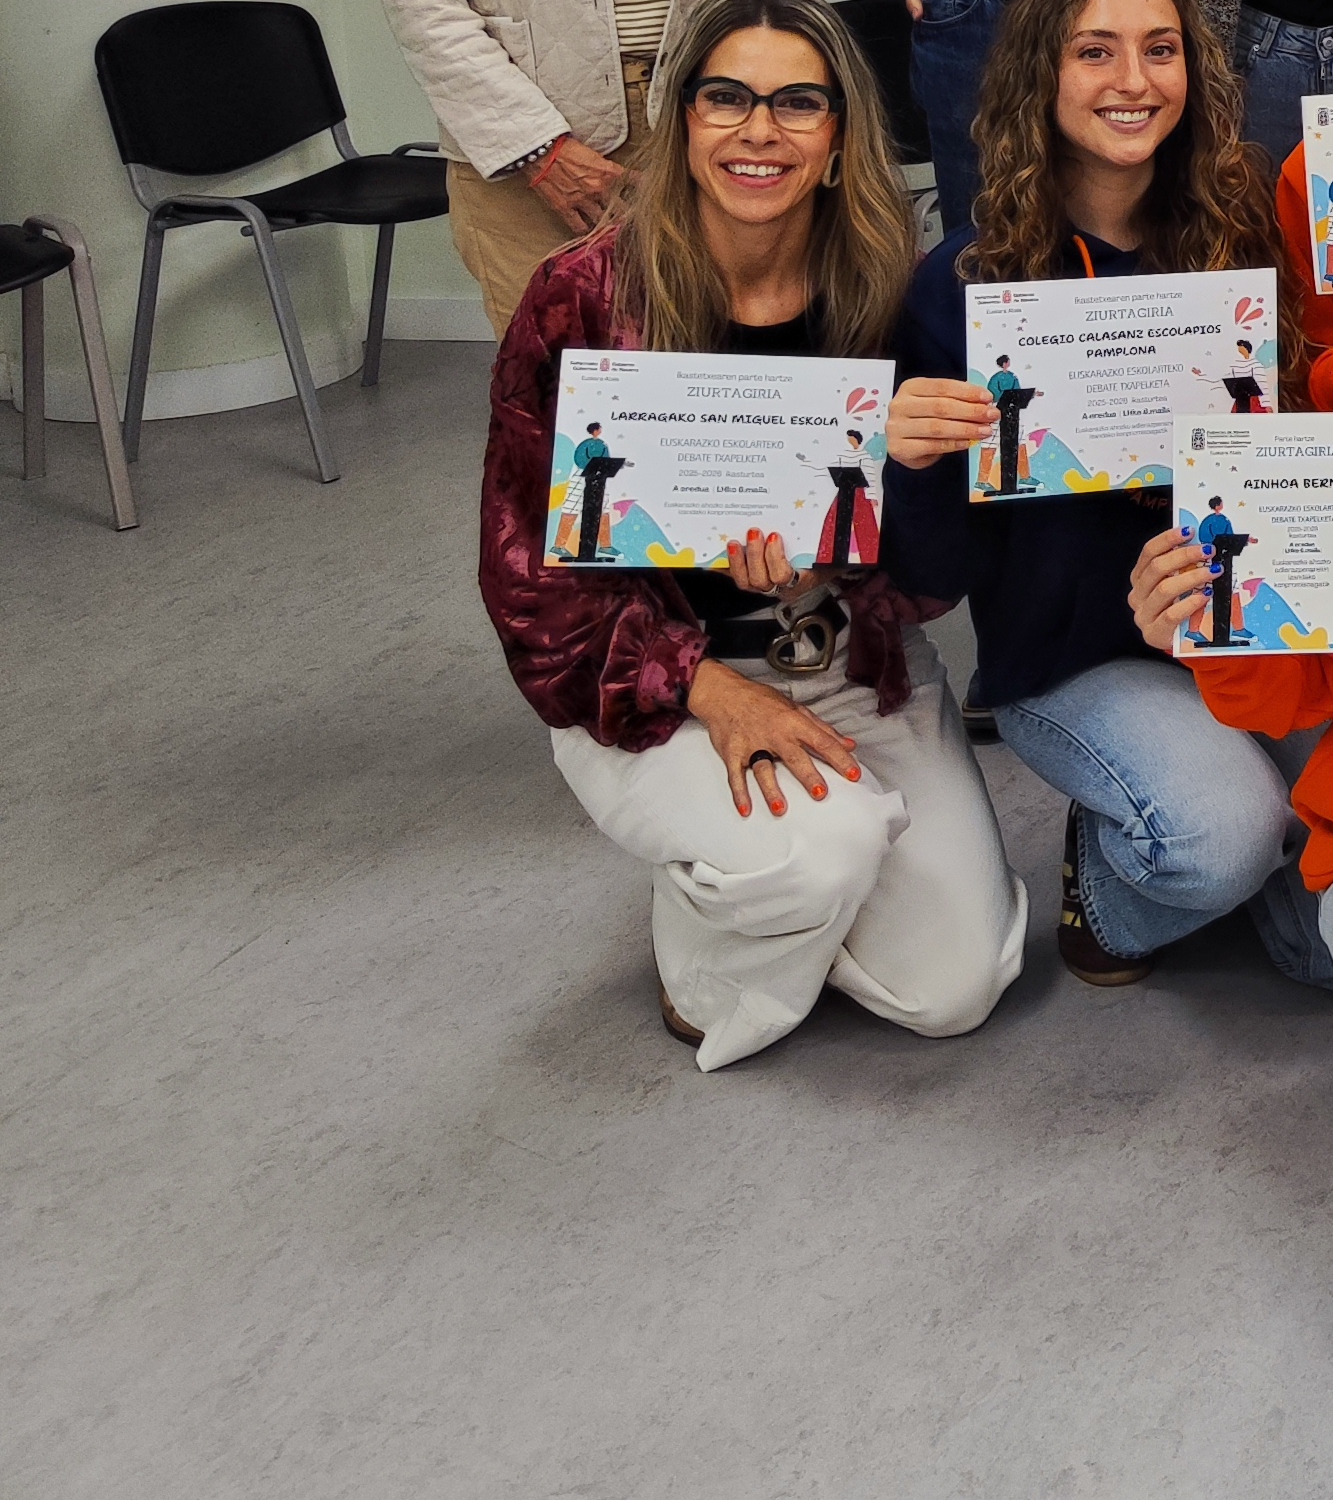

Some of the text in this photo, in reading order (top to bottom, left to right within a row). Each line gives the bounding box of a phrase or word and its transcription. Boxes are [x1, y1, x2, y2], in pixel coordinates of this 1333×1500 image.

[1085, 306, 1174, 322] ZIURTAGIRIA
[1018, 324, 1221, 347] COLEGIO CALASANZ ESCOLAPIOS
[1086, 345, 1156, 358] PAMPLONA
[686, 386, 782, 399] ZIURTAGIRIA
[610, 411, 838, 426] LARRAGAKO SAN MIGUEL ESKOLA
[660, 437, 720, 448] EUSKARAZKO
[677, 452, 712, 462] DEBATE
[1243, 479, 1299, 489] AINHOA
